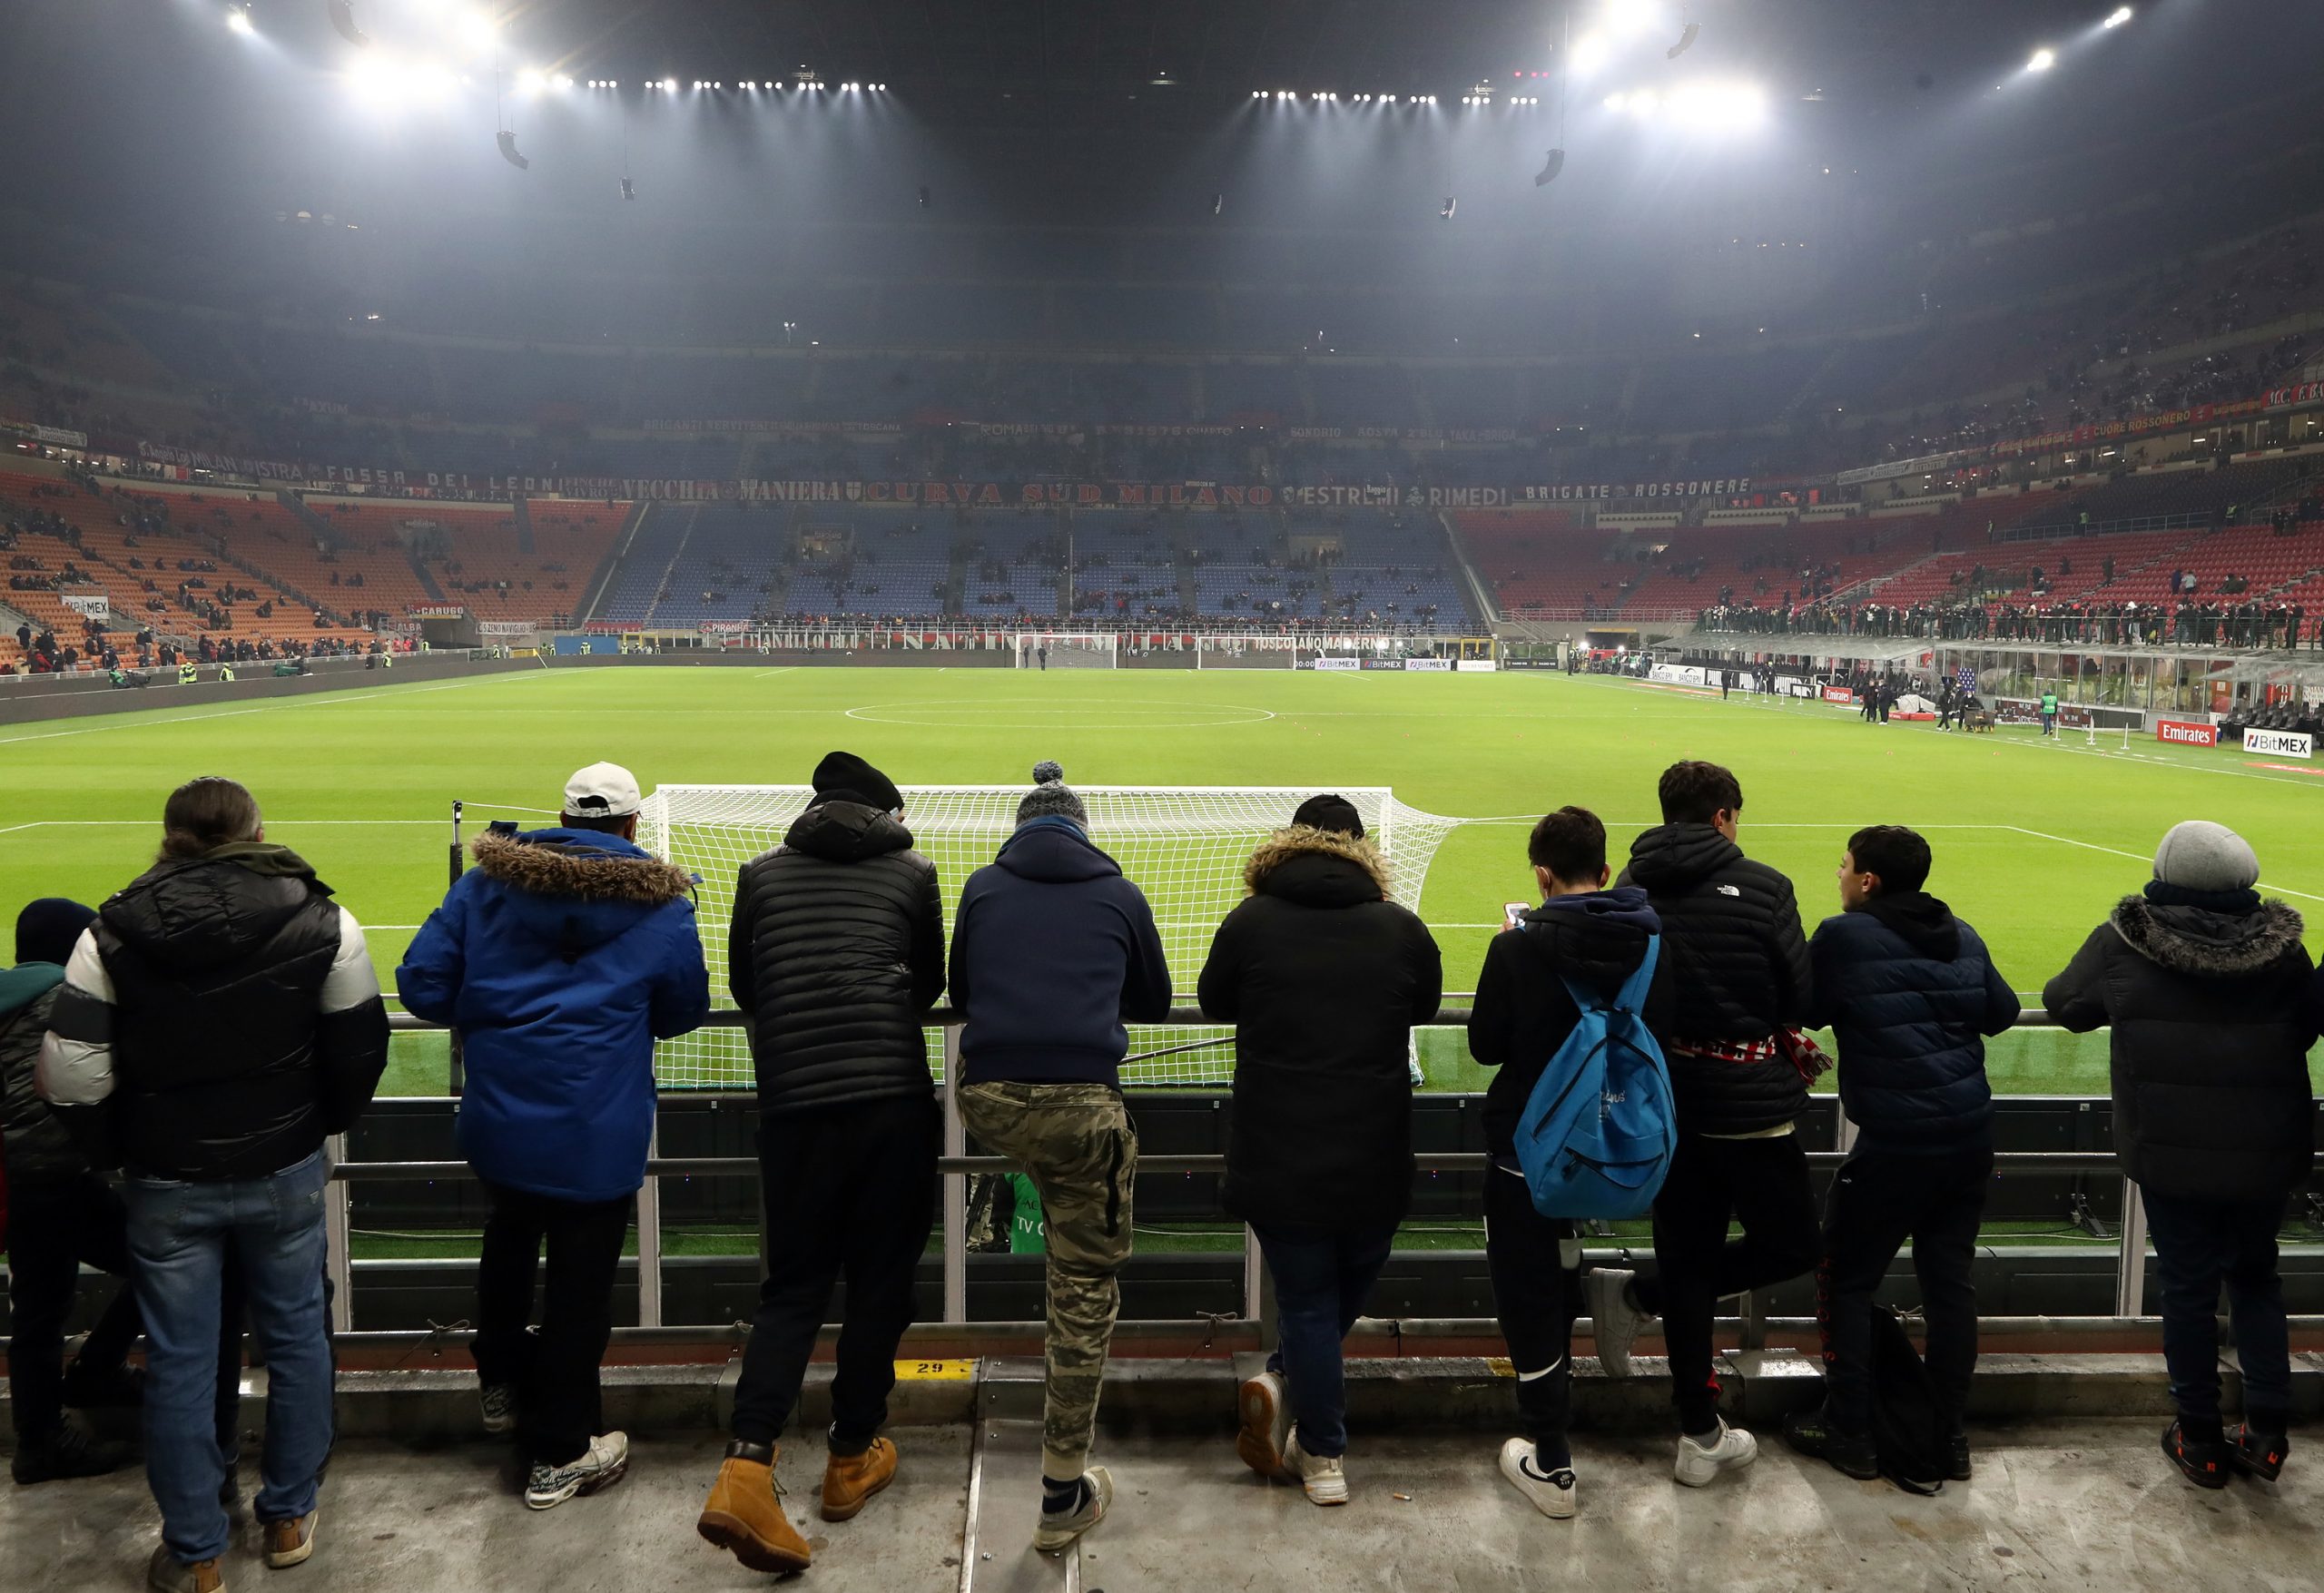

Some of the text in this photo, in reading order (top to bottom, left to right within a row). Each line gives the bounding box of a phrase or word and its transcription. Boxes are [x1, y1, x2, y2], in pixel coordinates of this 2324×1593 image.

[980, 424, 1023, 436] ROMA
[1290, 428, 1342, 438] SONDRIO
[2093, 410, 2191, 437] CUORE ROSSONERO
[192, 452, 237, 473] MILAN
[327, 466, 564, 491] FOSSA DEI LEONI
[623, 479, 720, 500] VECCHIA
[740, 480, 841, 501] MANIERA
[867, 481, 1274, 505] CURVA SUD MILANO
[1430, 487, 1507, 506] RIMEDI
[1525, 485, 1610, 499] BRIGATE
[1634, 478, 1750, 497] ROSSONERE
[421, 606, 464, 615] CARUGO
[713, 624, 749, 633] PIRANHA
[830, 634, 860, 649] BLU
[1826, 689, 1849, 702] Emirates
[2162, 724, 2211, 743] Emirates
[2260, 735, 2308, 754] BitMEX
[1017, 1215, 1033, 1235] TV
[916, 1363, 943, 1373] 29
